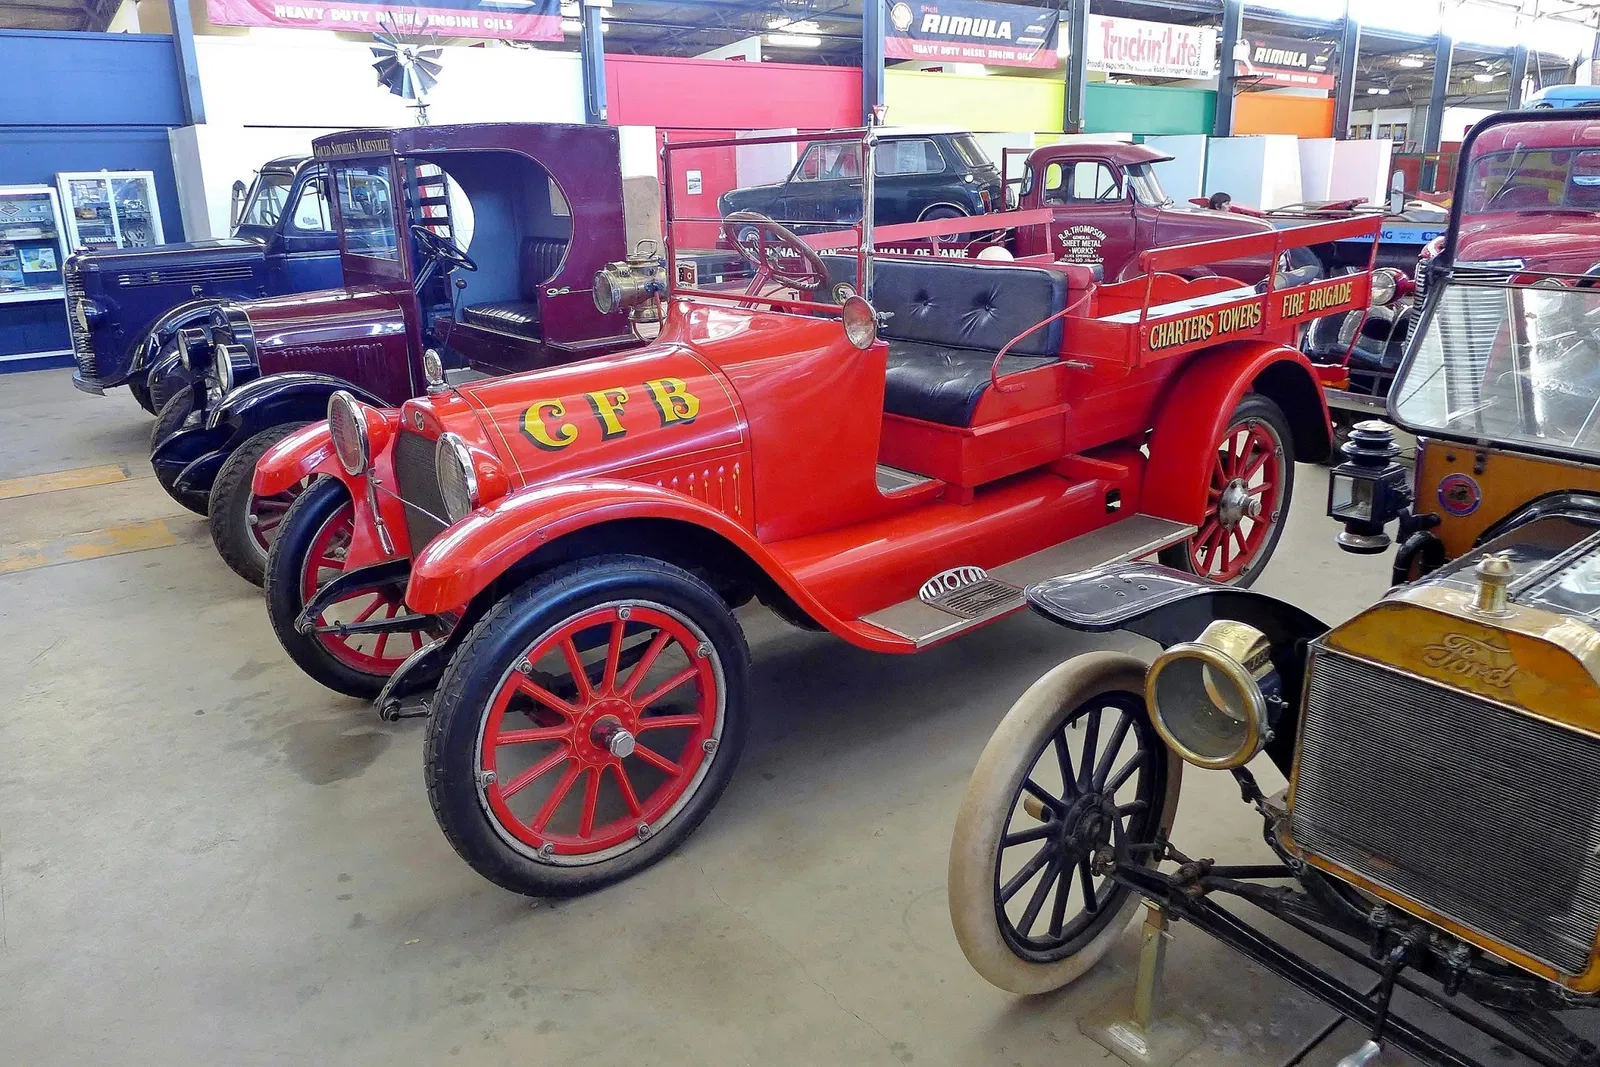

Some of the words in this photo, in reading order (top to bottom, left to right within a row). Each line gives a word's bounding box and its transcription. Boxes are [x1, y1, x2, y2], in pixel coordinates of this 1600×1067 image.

[274, 5, 324, 20] HEAVY
[330, 8, 370, 22] DUTY
[427, 14, 478, 28] ENGINE
[484, 18, 513, 30] OILS
[920, 5, 938, 13] Shell
[921, 14, 1012, 40] RIMULA
[912, 44, 938, 55] HEAVY
[941, 46, 960, 56] DUTY
[963, 47, 985, 58] DIESEL
[988, 49, 1014, 60] ENGINE
[1254, 47, 1307, 68] RIMULA
[1070, 225, 1107, 241] THOMPSON
[939, 249, 968, 258] AME
[1072, 247, 1093, 255] WORKS
[1281, 294, 1306, 318] FIRE
[1308, 282, 1353, 312] BRIGADE
[1150, 312, 1215, 349] CHARTERS
[1218, 302, 1262, 334] TOWERS
[1423, 632, 1519, 688] Ford
